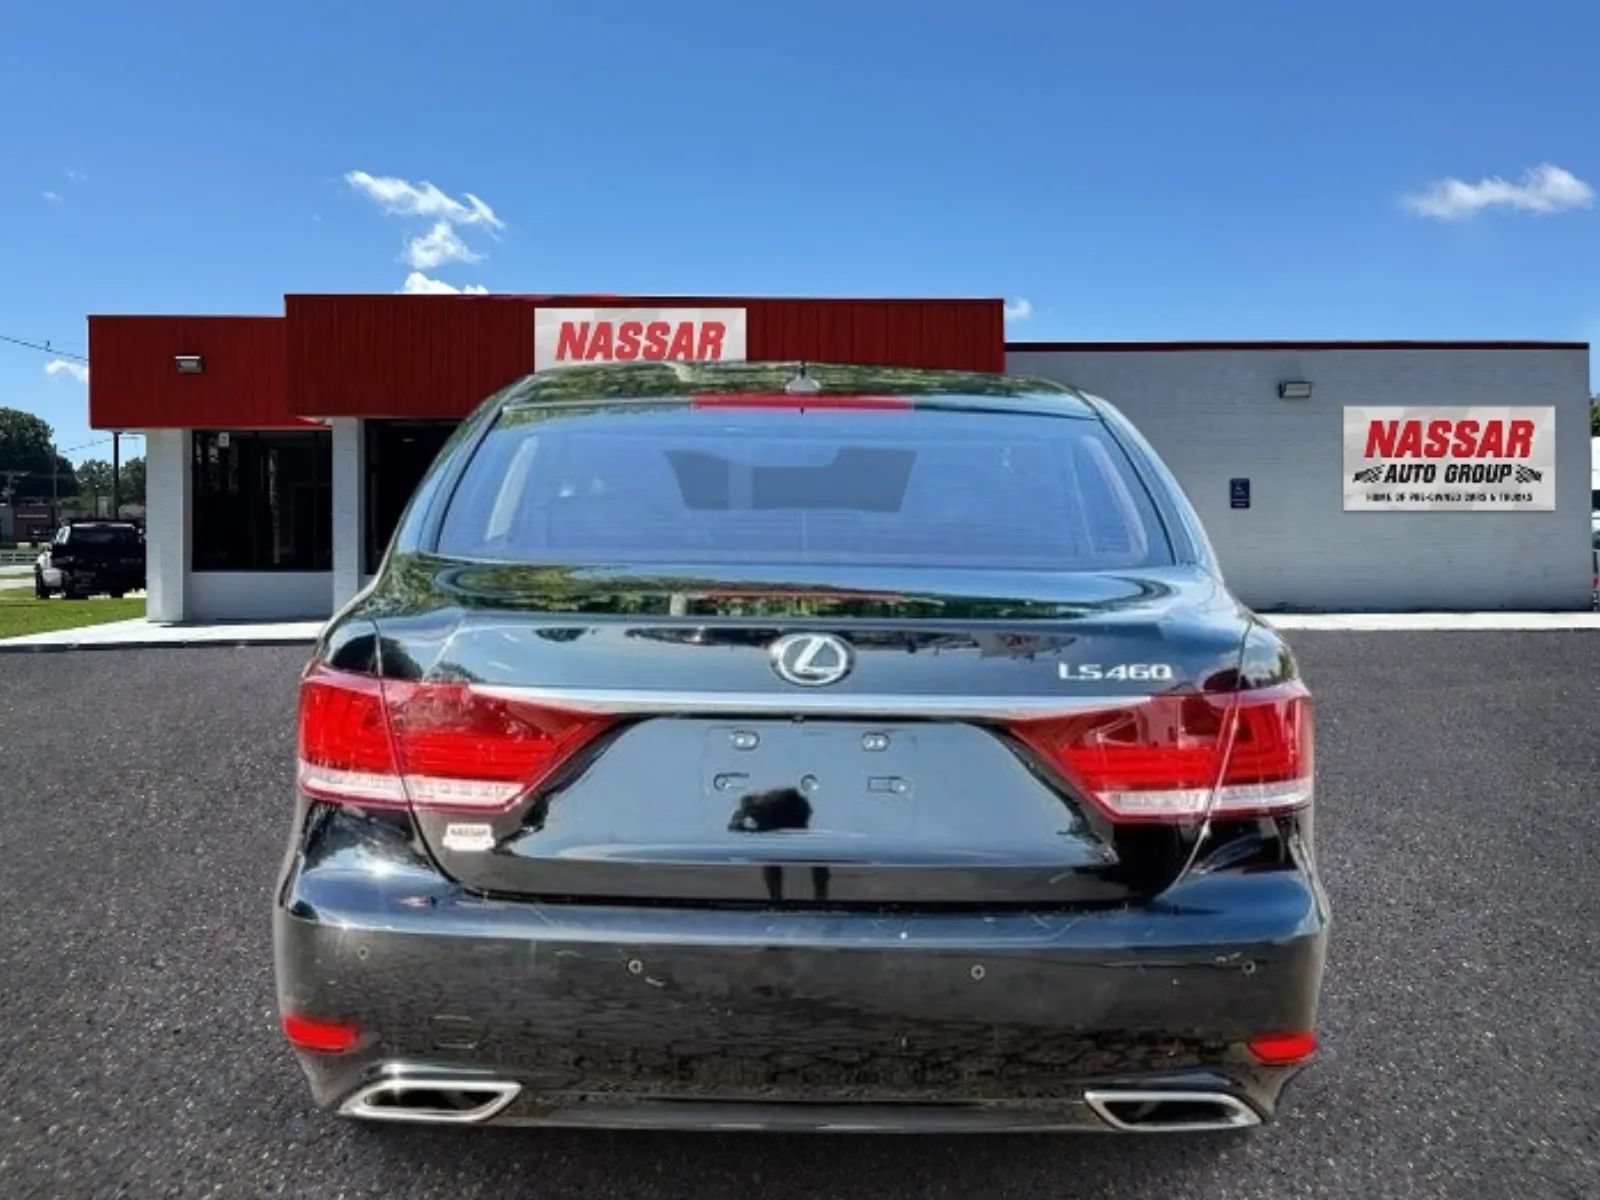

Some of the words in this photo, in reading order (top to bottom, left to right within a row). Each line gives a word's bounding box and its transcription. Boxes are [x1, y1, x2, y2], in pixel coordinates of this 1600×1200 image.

[555, 321, 726, 361] NASSAR
[1364, 420, 1535, 458] NASSAR
[1383, 464, 1436, 483] AUTO
[1444, 464, 1512, 483] GROUP
